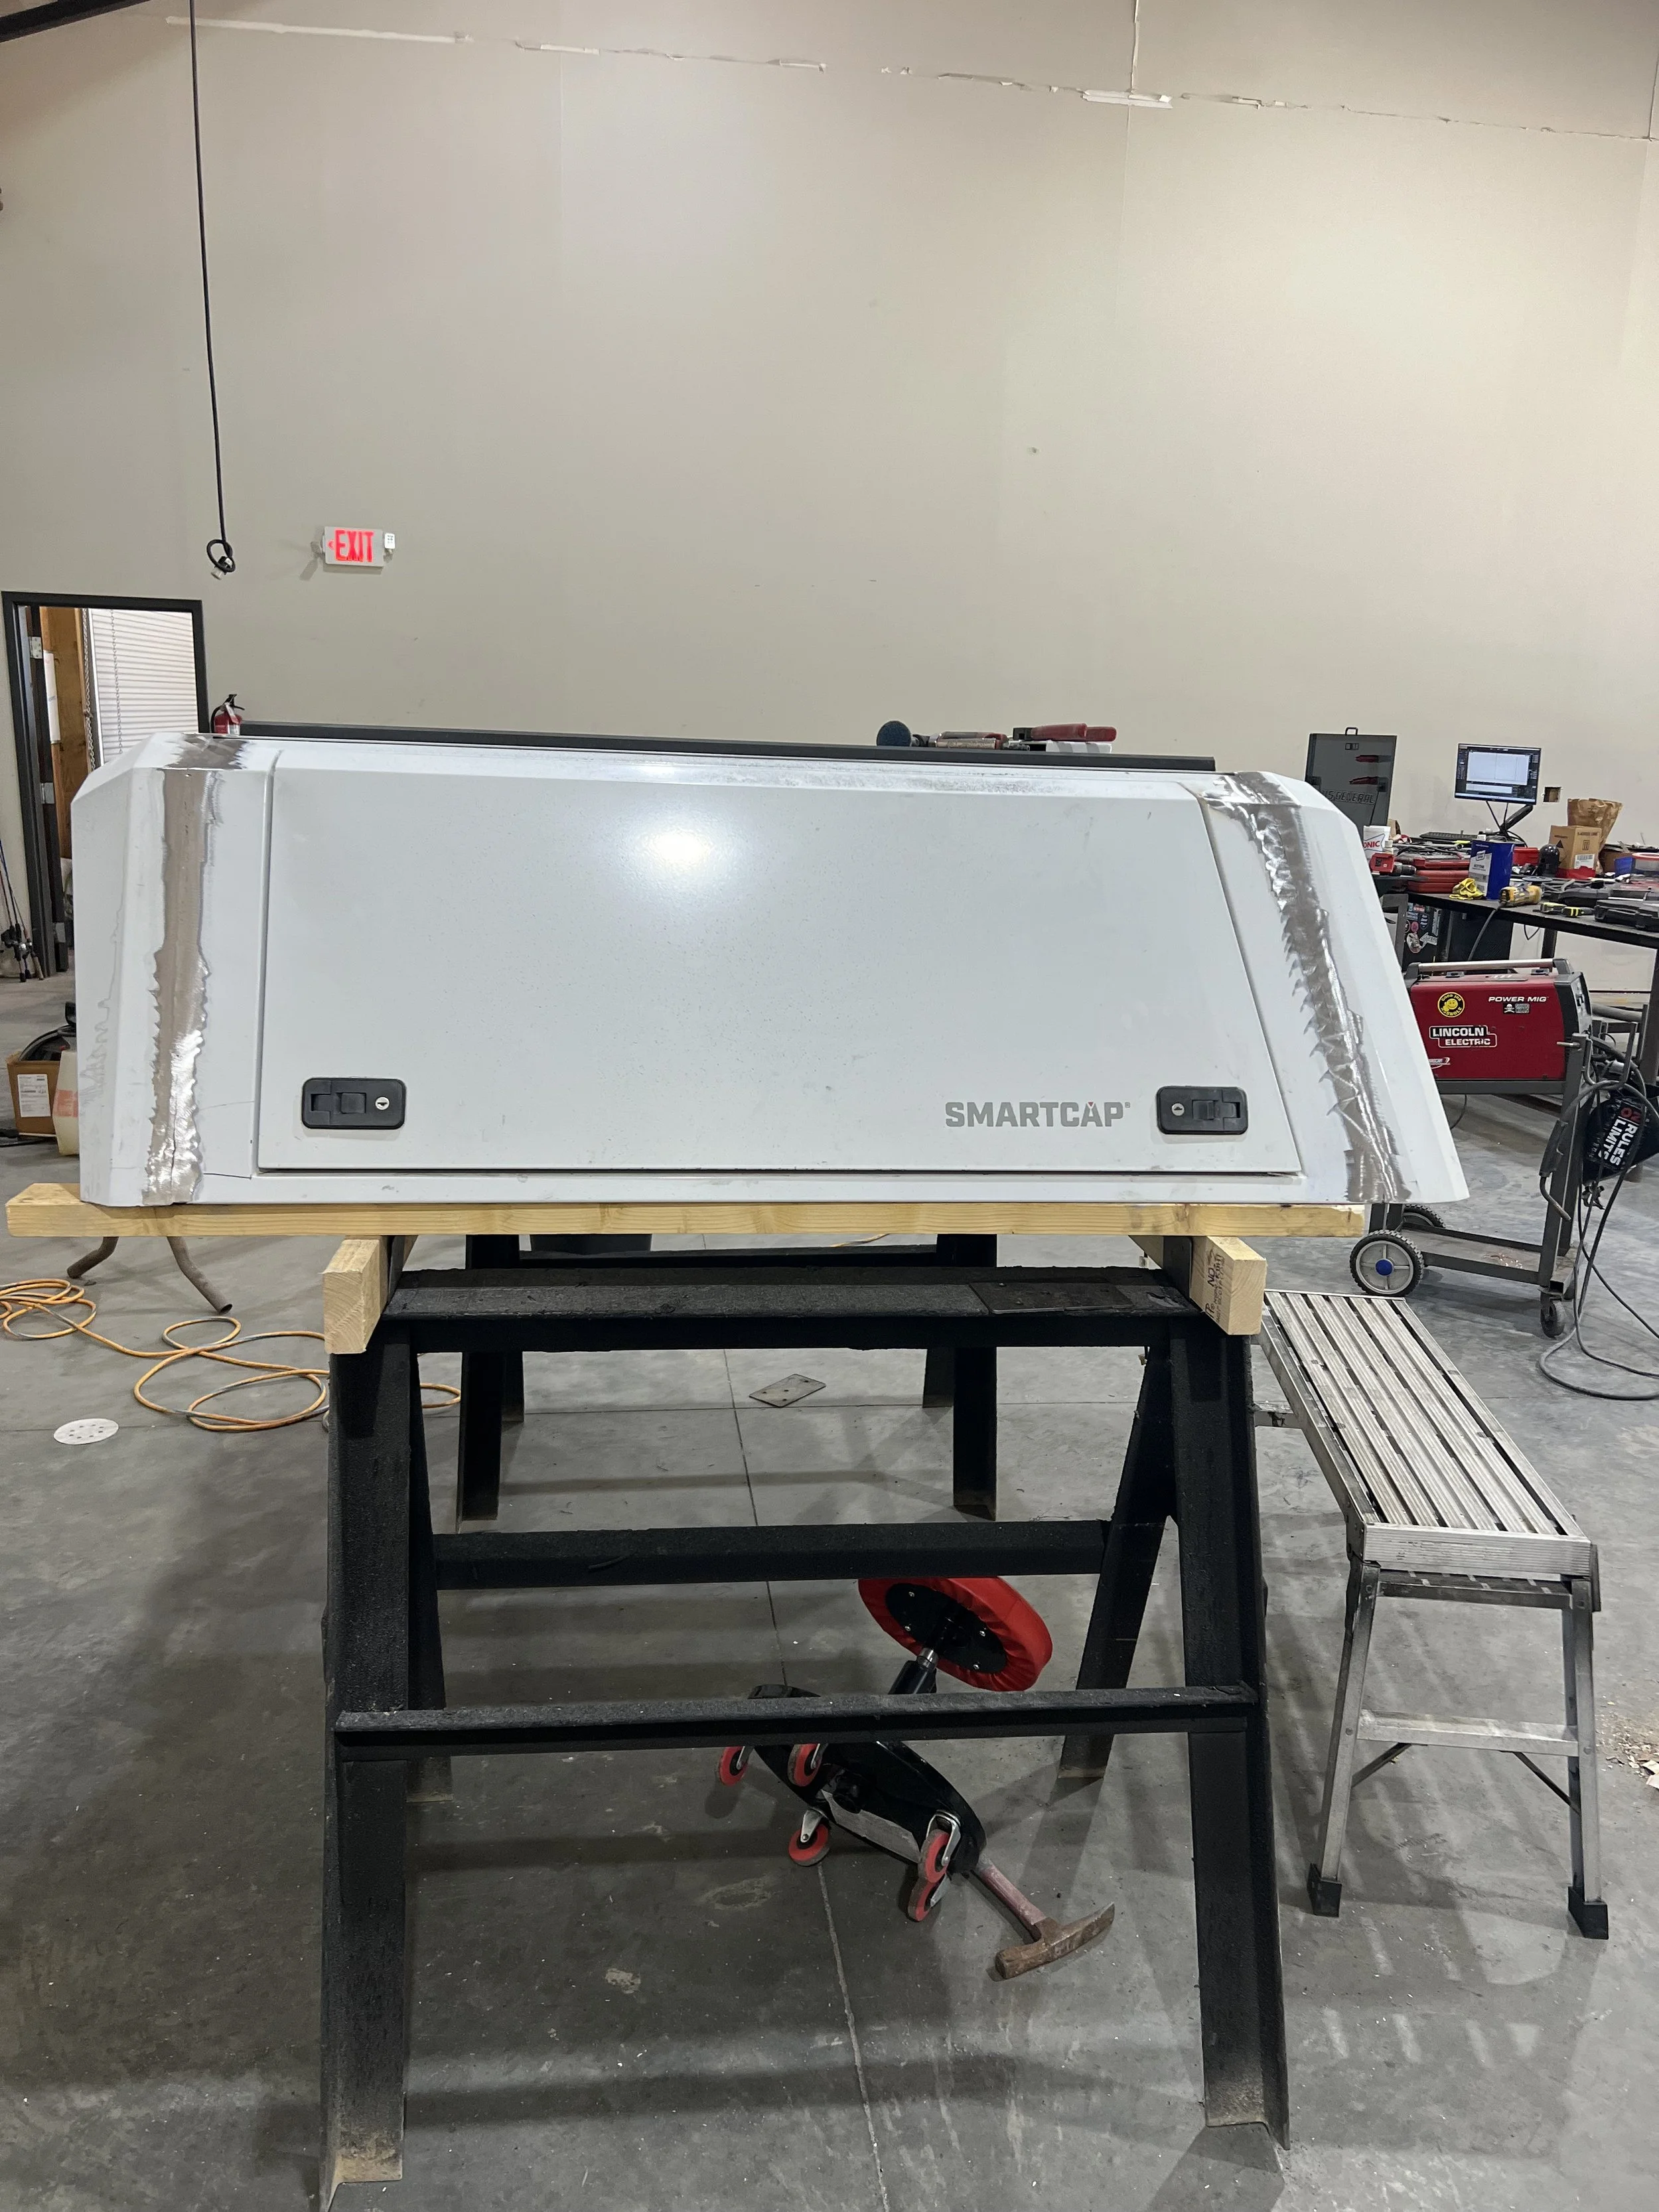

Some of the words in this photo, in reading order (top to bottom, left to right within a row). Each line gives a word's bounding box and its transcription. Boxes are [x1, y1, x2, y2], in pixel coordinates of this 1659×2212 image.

[335, 530, 374, 562] EXIT
[1336, 790, 1375, 804] GENERAL
[1433, 1027, 1484, 1037] LINCOLN
[1598, 1118, 1626, 1161] LIMITS
[1609, 1123, 1638, 1166] RULES
